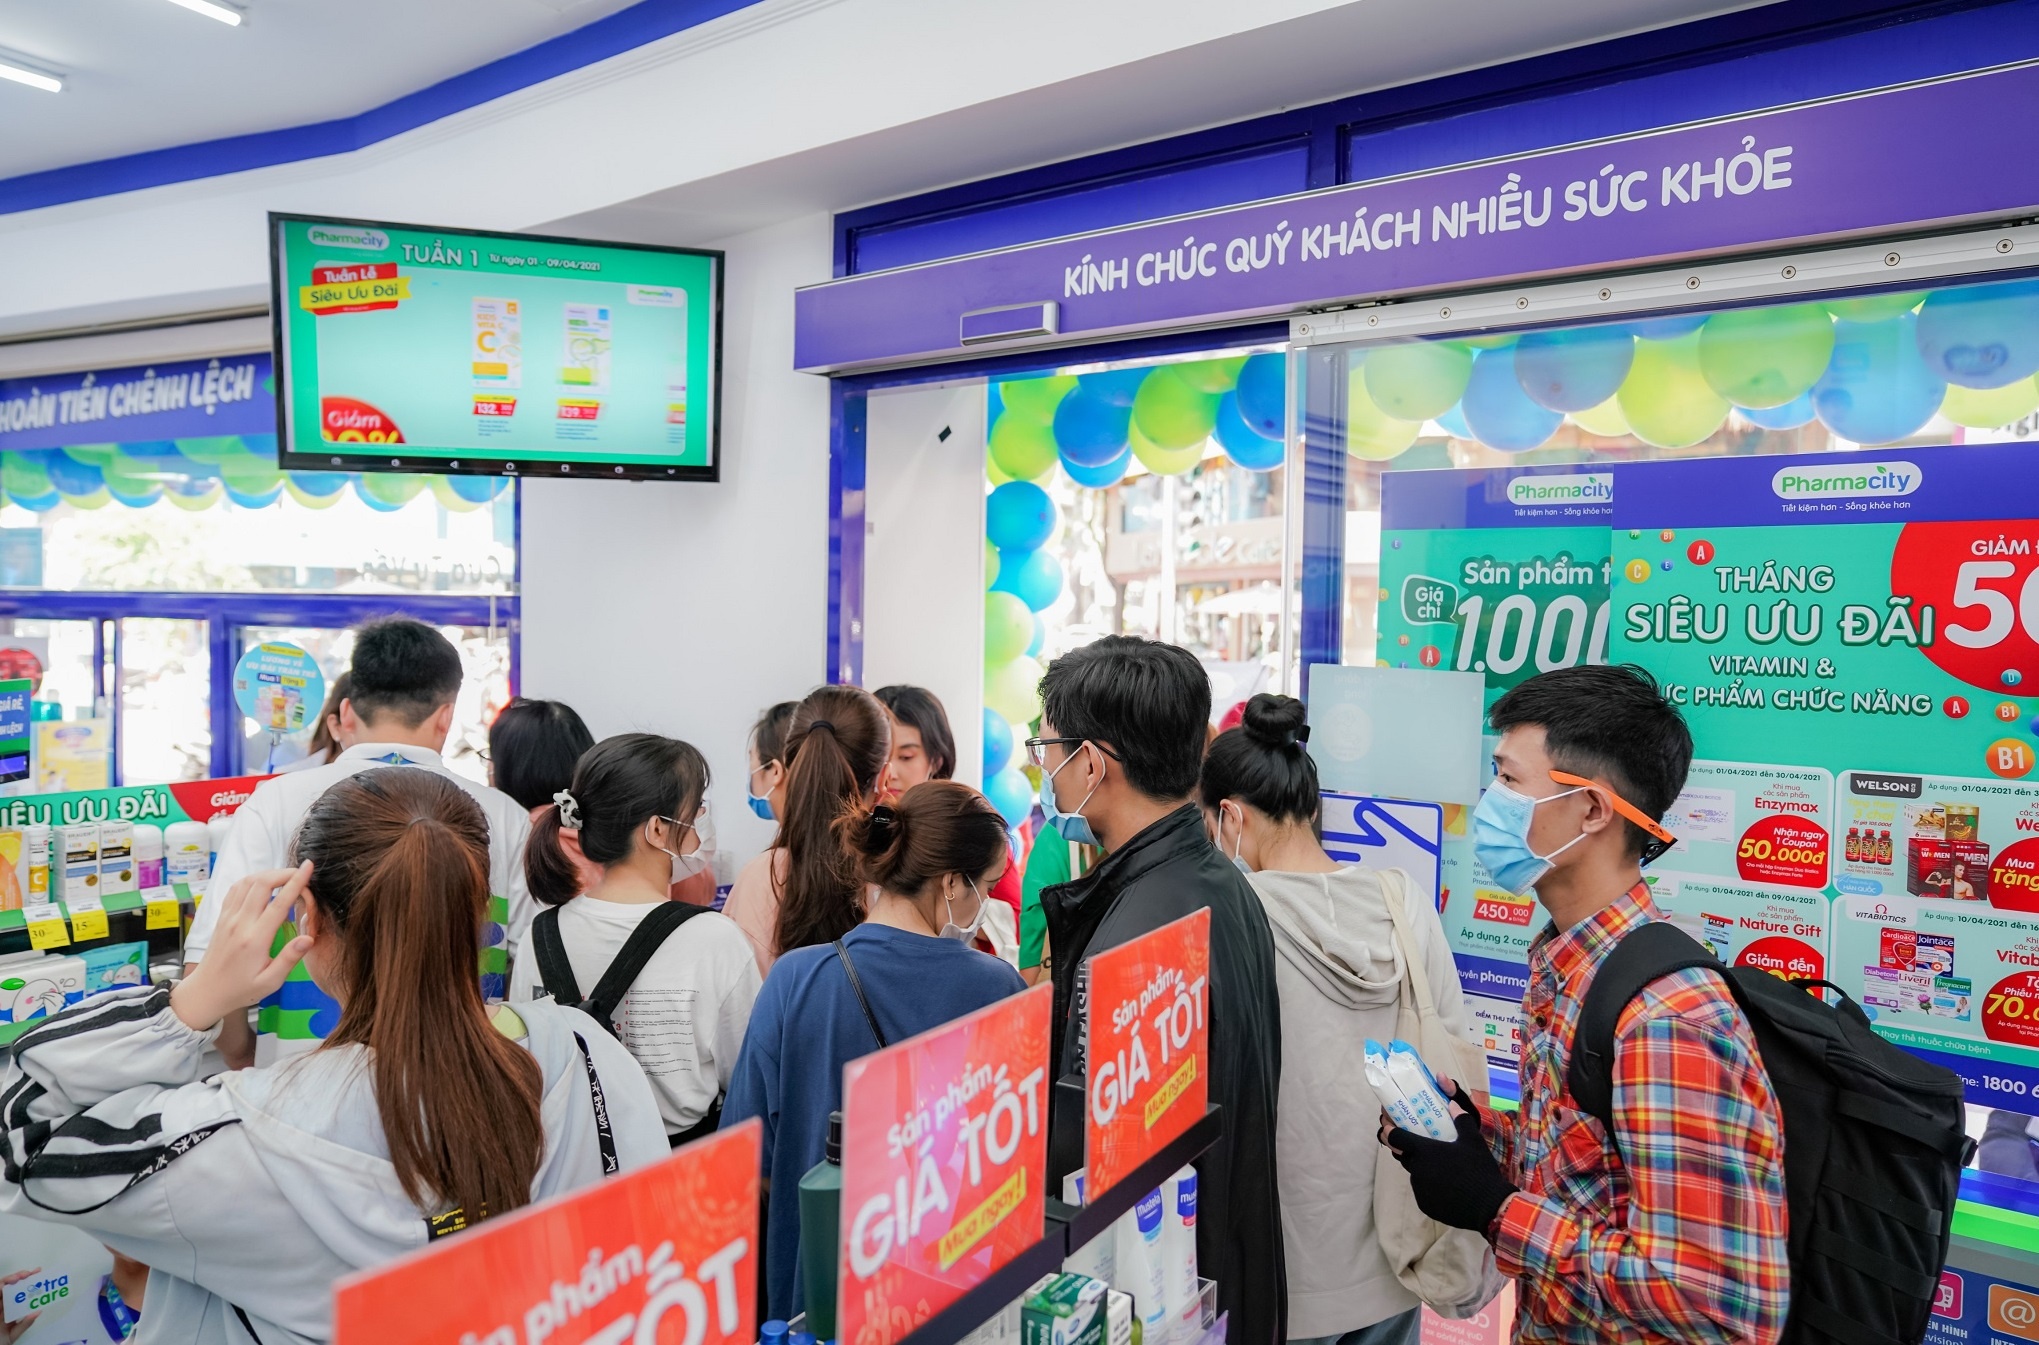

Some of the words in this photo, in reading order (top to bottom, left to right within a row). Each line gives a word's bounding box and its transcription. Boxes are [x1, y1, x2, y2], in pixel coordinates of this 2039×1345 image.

[1064, 254, 1128, 298] KÍNH
[1135, 236, 1217, 286] CHÚC
[1225, 220, 1293, 273] QUÝ
[1301, 206, 1421, 262] KHÁCH
[1432, 172, 1552, 241] NHIỀU
[1563, 164, 1648, 222] SỨC
[1661, 135, 1794, 206] KHỎE
[312, 230, 384, 248] Pharmacity
[469, 250, 479, 267] 1
[527, 257, 538, 265] 01
[547, 258, 601, 271] 09/04/2021
[311, 288, 342, 304] Siêu
[0, 387, 55, 433] HOÀN
[59, 372, 109, 425] TIỀN
[108, 368, 190, 418] CHÊNH
[190, 358, 256, 416] LỆCH
[1782, 465, 1911, 492] Pharmacity
[1514, 477, 1613, 500] Pharmacity
[1798, 503, 1818, 512] kiệm
[1821, 502, 1837, 511] hơn
[1869, 501, 1891, 509] khỏe
[1893, 501, 1911, 509] hơn
[1696, 545, 1705, 560] A
[1971, 535, 2030, 557] GIẢM
[1464, 557, 1510, 585] Sản
[1518, 555, 1593, 590] phẩm
[1633, 564, 1641, 578] C
[1715, 560, 1834, 593] THÁNG
[1415, 586, 1444, 603] Giá
[1626, 596, 1727, 642] SIÊU
[1746, 600, 1822, 645] ƯU
[1839, 596, 1935, 646] ĐÃI
[1426, 650, 1434, 663] A
[1710, 655, 1808, 677] VITAMIN
[1816, 657, 1835, 677] &
[2008, 673, 2014, 683] D
[1694, 678, 1765, 709] PHẨM
[1773, 686, 1844, 711] CHỨC
[1852, 688, 1932, 716] NĂNG
[1952, 701, 1961, 714] A
[2001, 706, 2015, 718] B1
[1997, 746, 2024, 770] B1
[1716, 768, 1757, 777] 01/04/2021
[1775, 772, 1821, 781] 30/04/2021
[1856, 779, 1909, 792] WELSON
[1961, 785, 2011, 795] 01/04/2021
[2014, 787, 2031, 797] đến
[63, 797, 108, 825] ƯU
[118, 789, 168, 819] ĐÃI
[211, 791, 250, 808] Giảm
[1755, 797, 1819, 813] Enzymax
[1774, 827, 1798, 838] Nhận
[1801, 830, 1824, 841] ngay
[1738, 838, 1826, 865] 50.000đ
[1782, 838, 1818, 848] Coupon
[1964, 853, 1988, 862] MEN
[2005, 857, 2035, 870] Mua
[33, 872, 43, 884] C
[1712, 887, 1753, 898] 01/04/2021
[1756, 891, 1770, 899] đến
[1772, 893, 1816, 905] 09/04/2021
[150, 908, 160, 917] 30
[1477, 903, 1512, 921] 450.
[1513, 907, 1528, 916] 000
[1784, 914, 1804, 922] phẩm
[1856, 912, 1907, 924] VITABIOTICS
[75, 921, 87, 931] 15
[1740, 917, 1789, 933] Nature
[1793, 924, 1821, 937] Gift
[1936, 914, 1956, 922] dụng:
[1958, 915, 2008, 928] 10/04/2021
[2010, 921, 2027, 930] đến
[32, 929, 45, 940] 30
[1477, 931, 1500, 944] dụng
[1503, 935, 1509, 943] 2
[1918, 935, 1954, 947] Jointace
[1746, 953, 1784, 969] Giảm
[1787, 958, 1815, 973] đến
[1899, 973, 1930, 985] Liveril
[1112, 999, 1137, 1034] Sản
[1140, 966, 1174, 1017] phẩm
[2004, 987, 2032, 998] Phiếu
[1092, 1019, 1150, 1129] GIÁ
[1154, 969, 1206, 1064] TỐT
[1881, 1030, 1900, 1040] thay
[1968, 1044, 1991, 1055] bệnh
[1146, 1092, 1167, 1121] Mua
[1168, 1053, 1194, 1096] ngay!
[1982, 1075, 2026, 1095] 1800
[887, 1112, 931, 1159] Sản
[935, 1062, 992, 1132] phẩm
[850, 1135, 949, 1283] GIÁ
[958, 1063, 1044, 1187] TỐT
[1136, 1192, 1162, 1217] mustela
[943, 1218, 977, 1257] Mua
[981, 1172, 1022, 1225] ngay!
[30, 1286, 69, 1309] care
[1942, 1323, 1968, 1339] HÌNH
